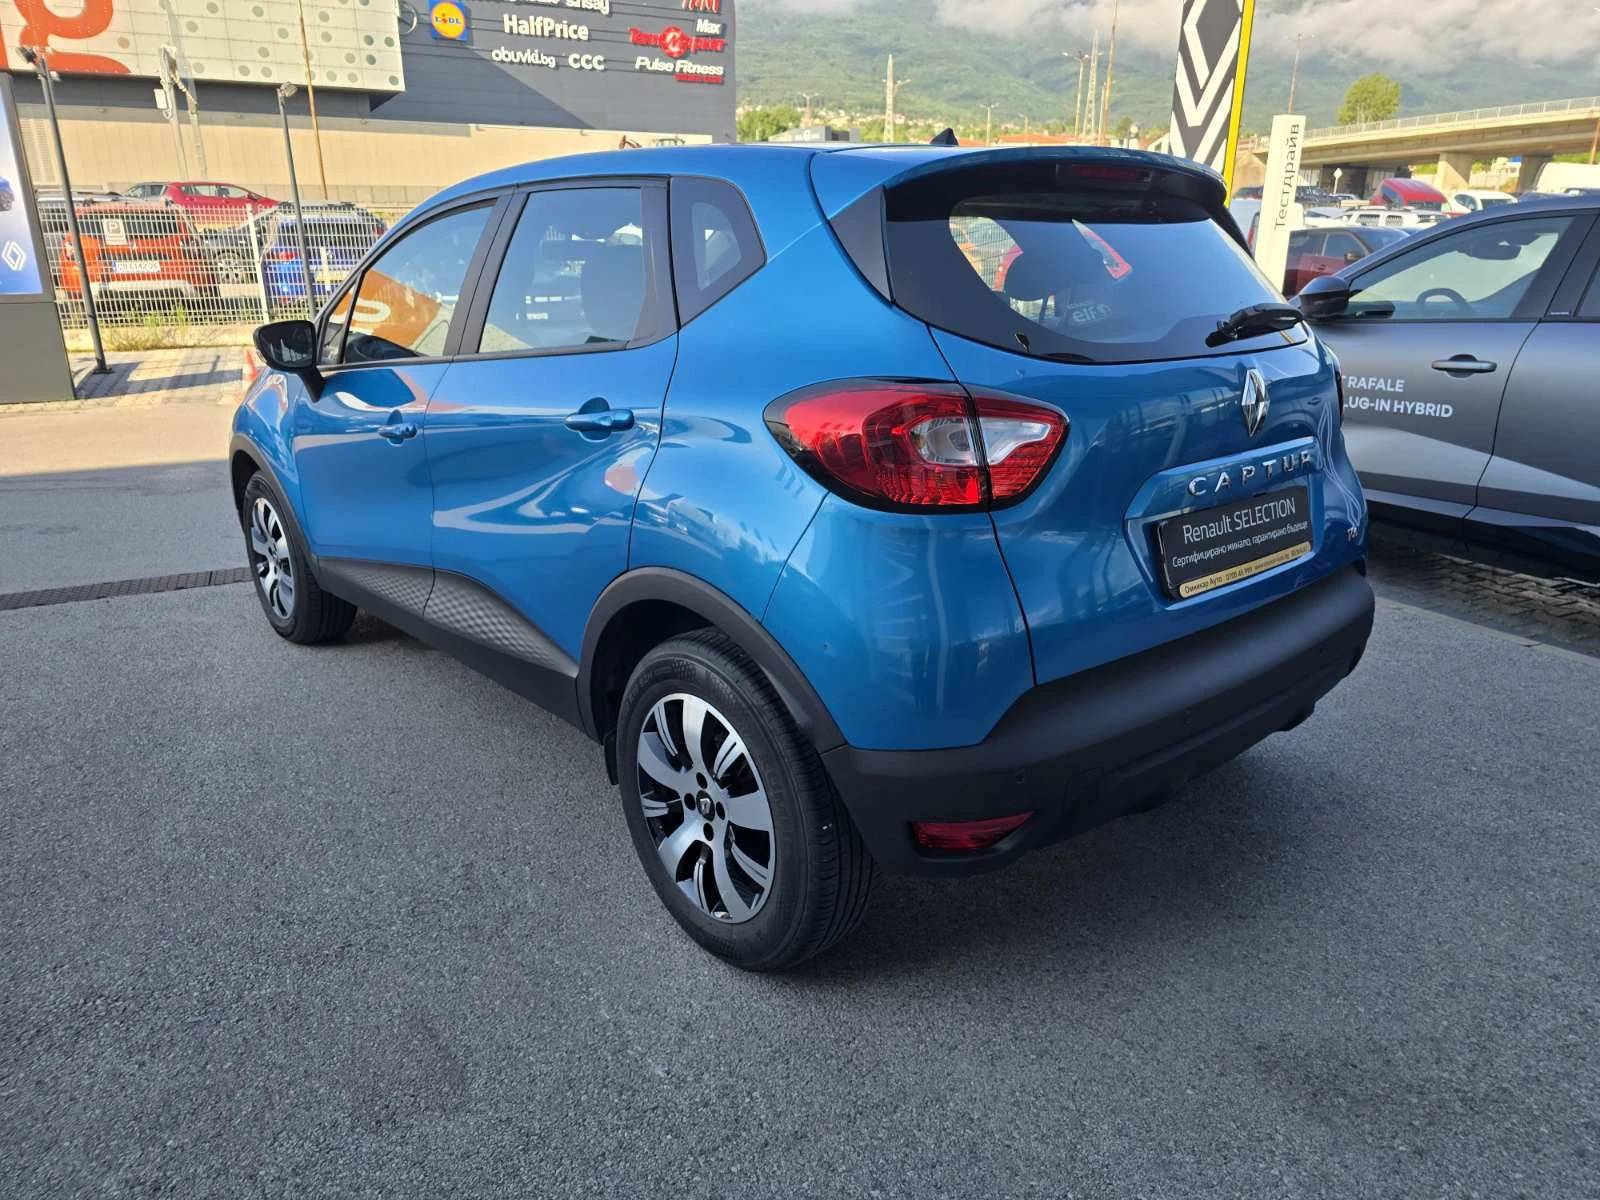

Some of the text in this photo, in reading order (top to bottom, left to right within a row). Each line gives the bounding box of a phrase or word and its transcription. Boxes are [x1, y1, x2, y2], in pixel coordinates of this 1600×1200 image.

[503, 13, 589, 41] HalfPrice
[696, 18, 721, 34] Max
[491, 45, 556, 69] obuvki.bg
[635, 56, 724, 76] Pulse Fitness
[1274, 123, 1300, 231] Тестдрайв
[1347, 375, 1406, 393] RAFALE
[1393, 400, 1453, 418] HYBRID
[1188, 451, 1314, 496] CAPTUR
[1182, 496, 1296, 545] Renault SELECTION
[1172, 544, 1227, 569] Сертифицирано
